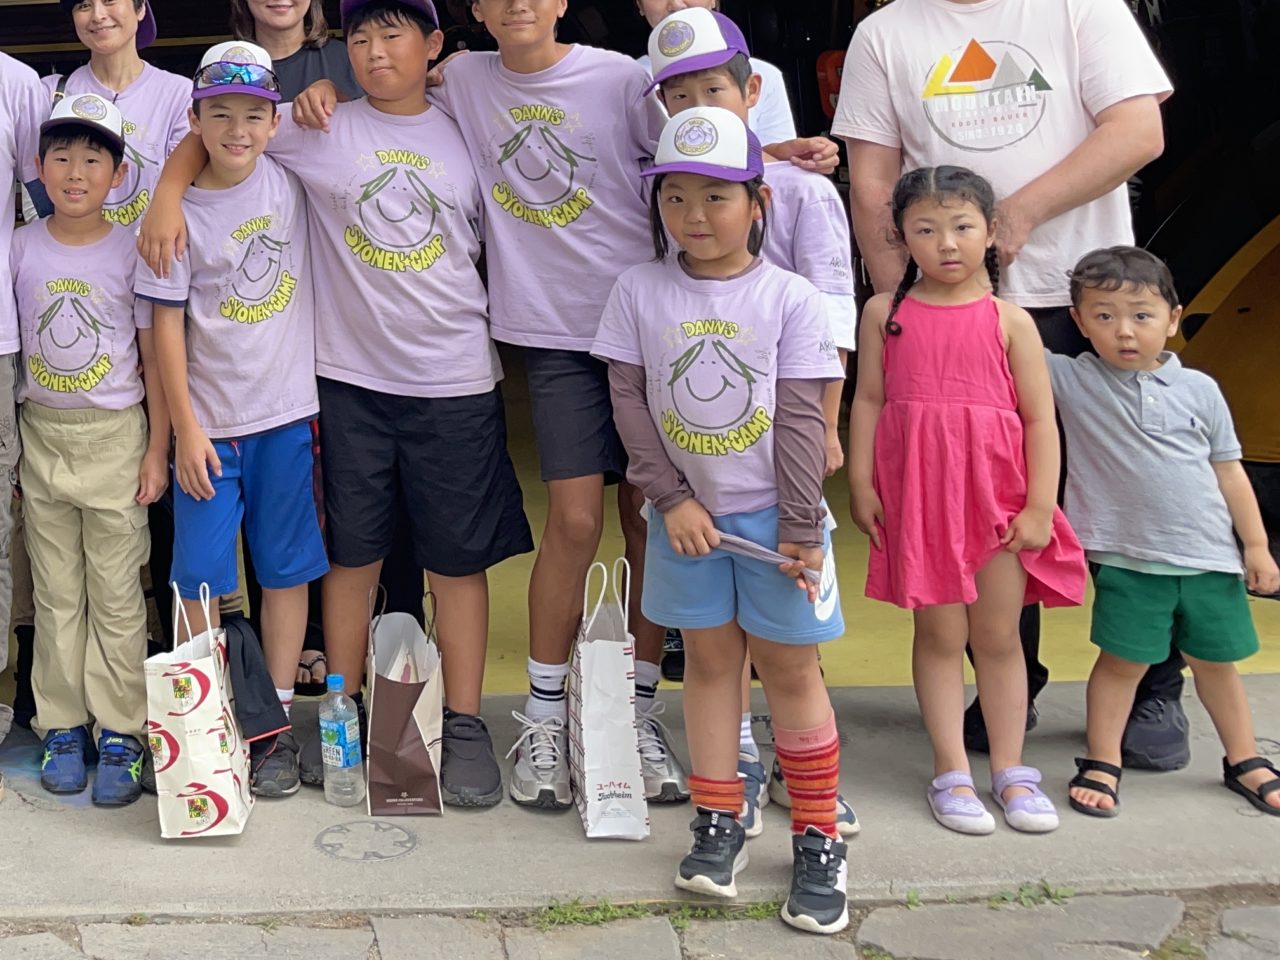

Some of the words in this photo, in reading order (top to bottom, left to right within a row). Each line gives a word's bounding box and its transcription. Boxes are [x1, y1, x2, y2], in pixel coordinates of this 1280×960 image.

[596, 781, 631, 790] ユーハイム
